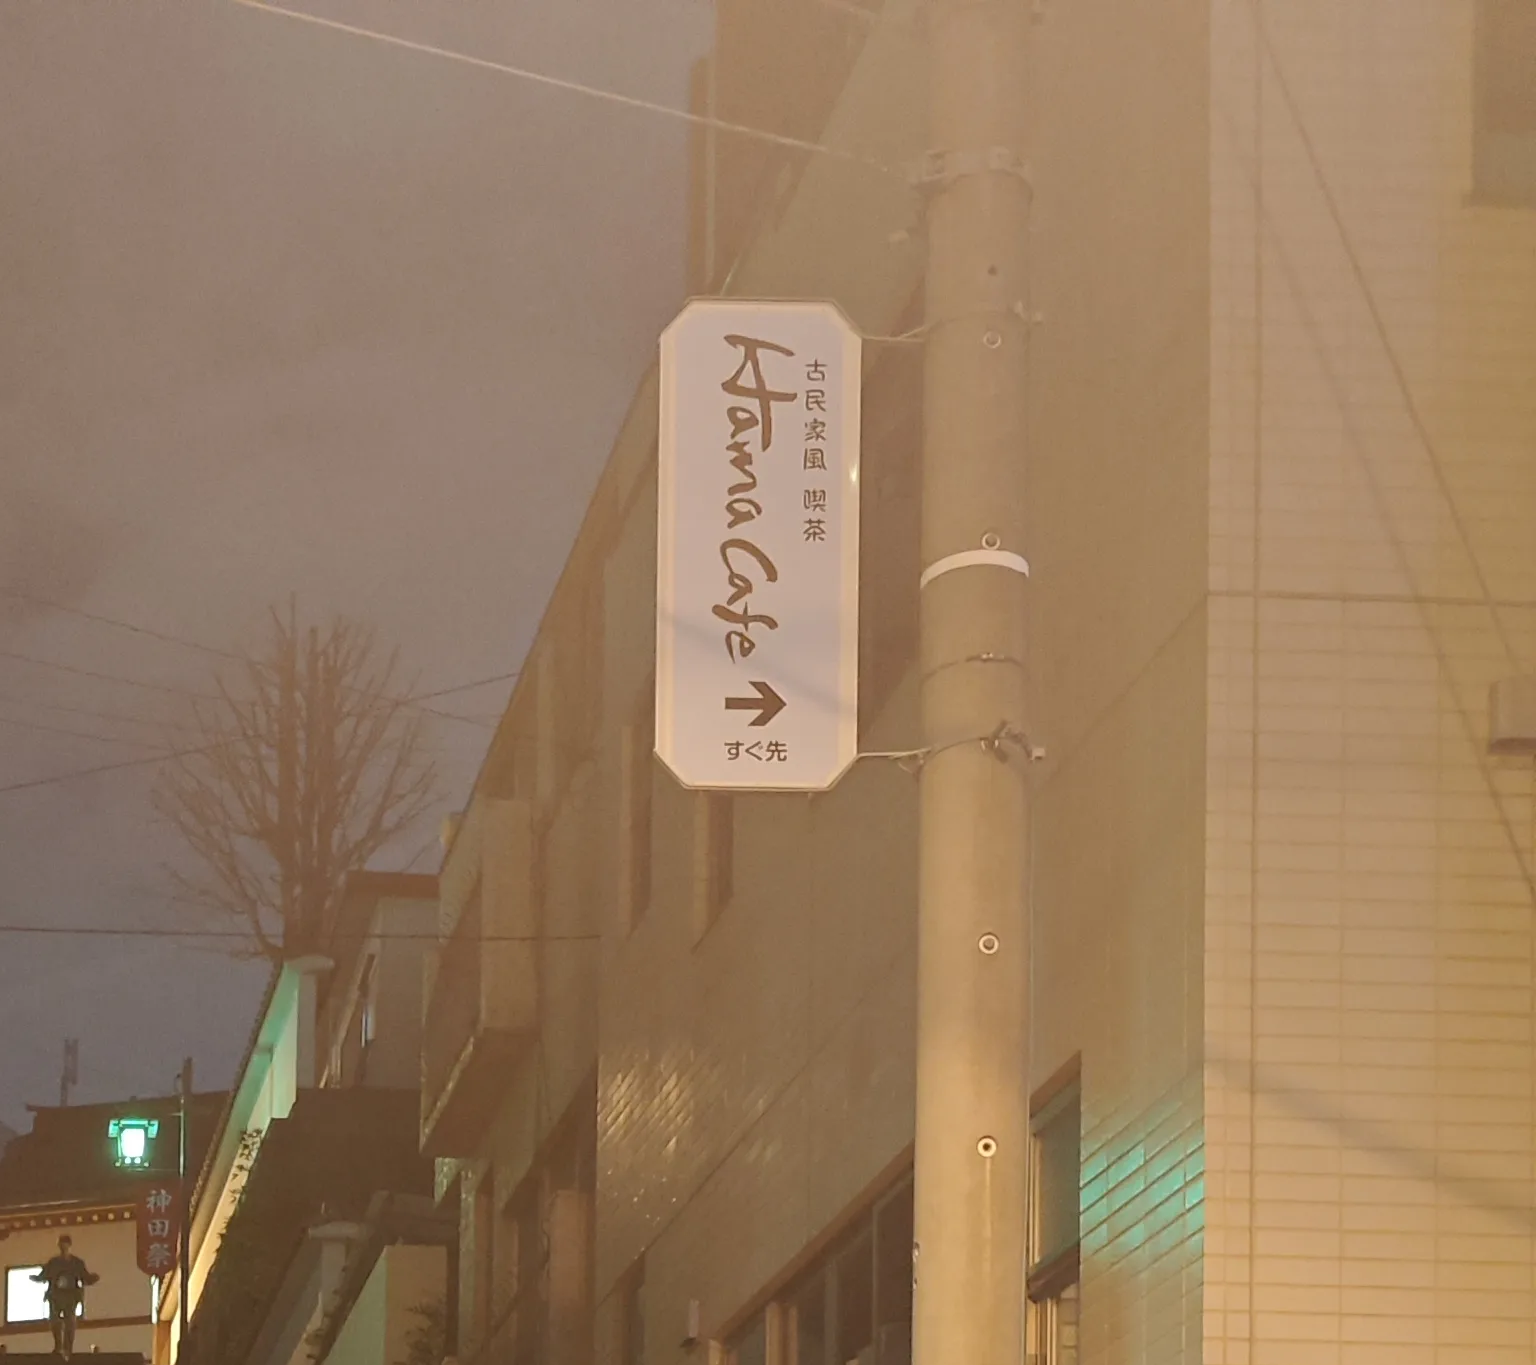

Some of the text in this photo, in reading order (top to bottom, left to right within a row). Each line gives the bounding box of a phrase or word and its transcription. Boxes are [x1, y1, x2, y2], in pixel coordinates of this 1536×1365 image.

[720, 333, 798, 529] Hama
[801, 357, 829, 543] 古民家風 喫茶
[723, 740, 789, 763] すぐ先
[145, 1188, 173, 1270] 神田祭
